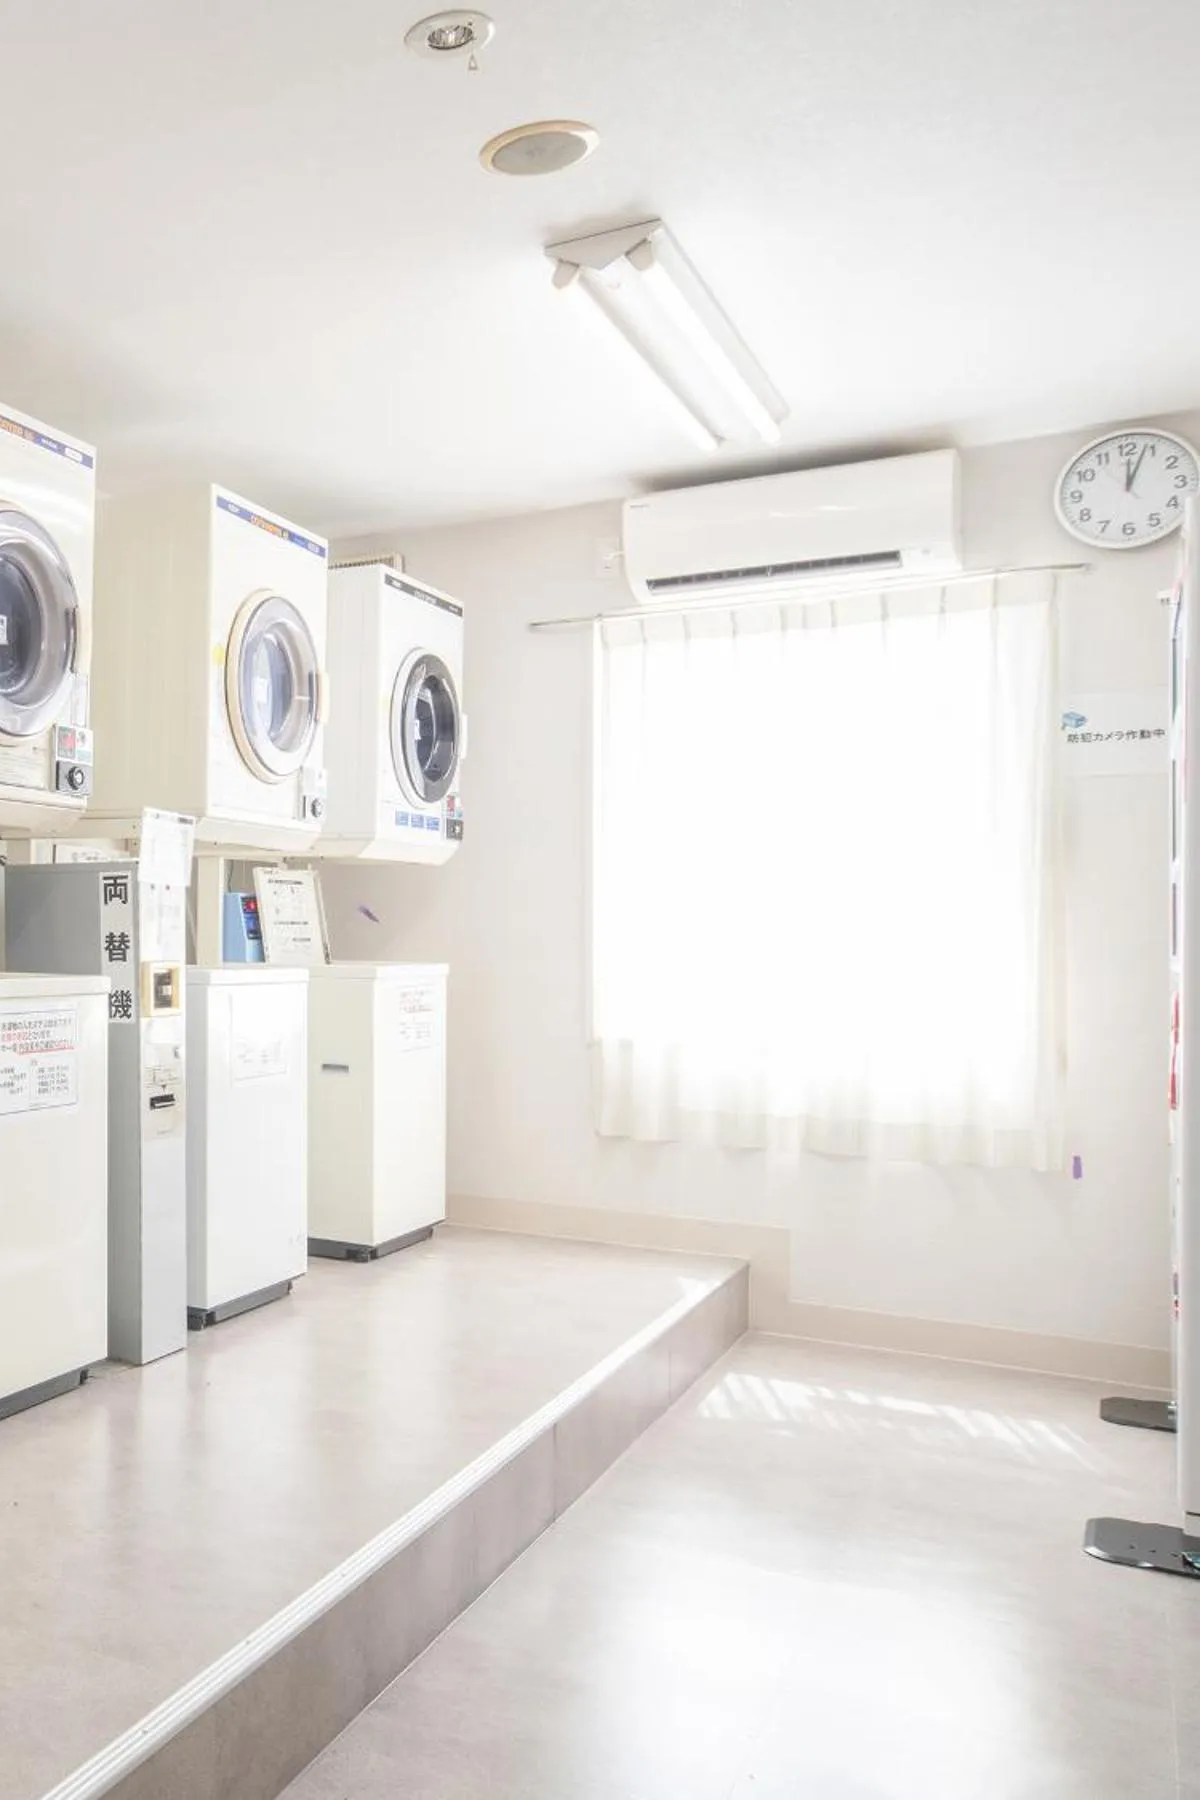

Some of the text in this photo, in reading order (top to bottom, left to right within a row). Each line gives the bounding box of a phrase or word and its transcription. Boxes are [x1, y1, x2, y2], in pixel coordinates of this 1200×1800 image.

[1118, 442, 1137, 457] 12
[1150, 444, 1156, 457] 1
[1097, 452, 1110, 466] 11
[1166, 455, 1179, 470] 2
[1076, 468, 1096, 483] 10
[1174, 475, 1188, 489] 3
[1070, 490, 1083, 503] 9
[1166, 495, 1179, 509] 4
[1080, 508, 1091, 521] 8
[1148, 513, 1161, 527] 5
[1097, 519, 1112, 533] 7
[1122, 522, 1136, 536] 6
